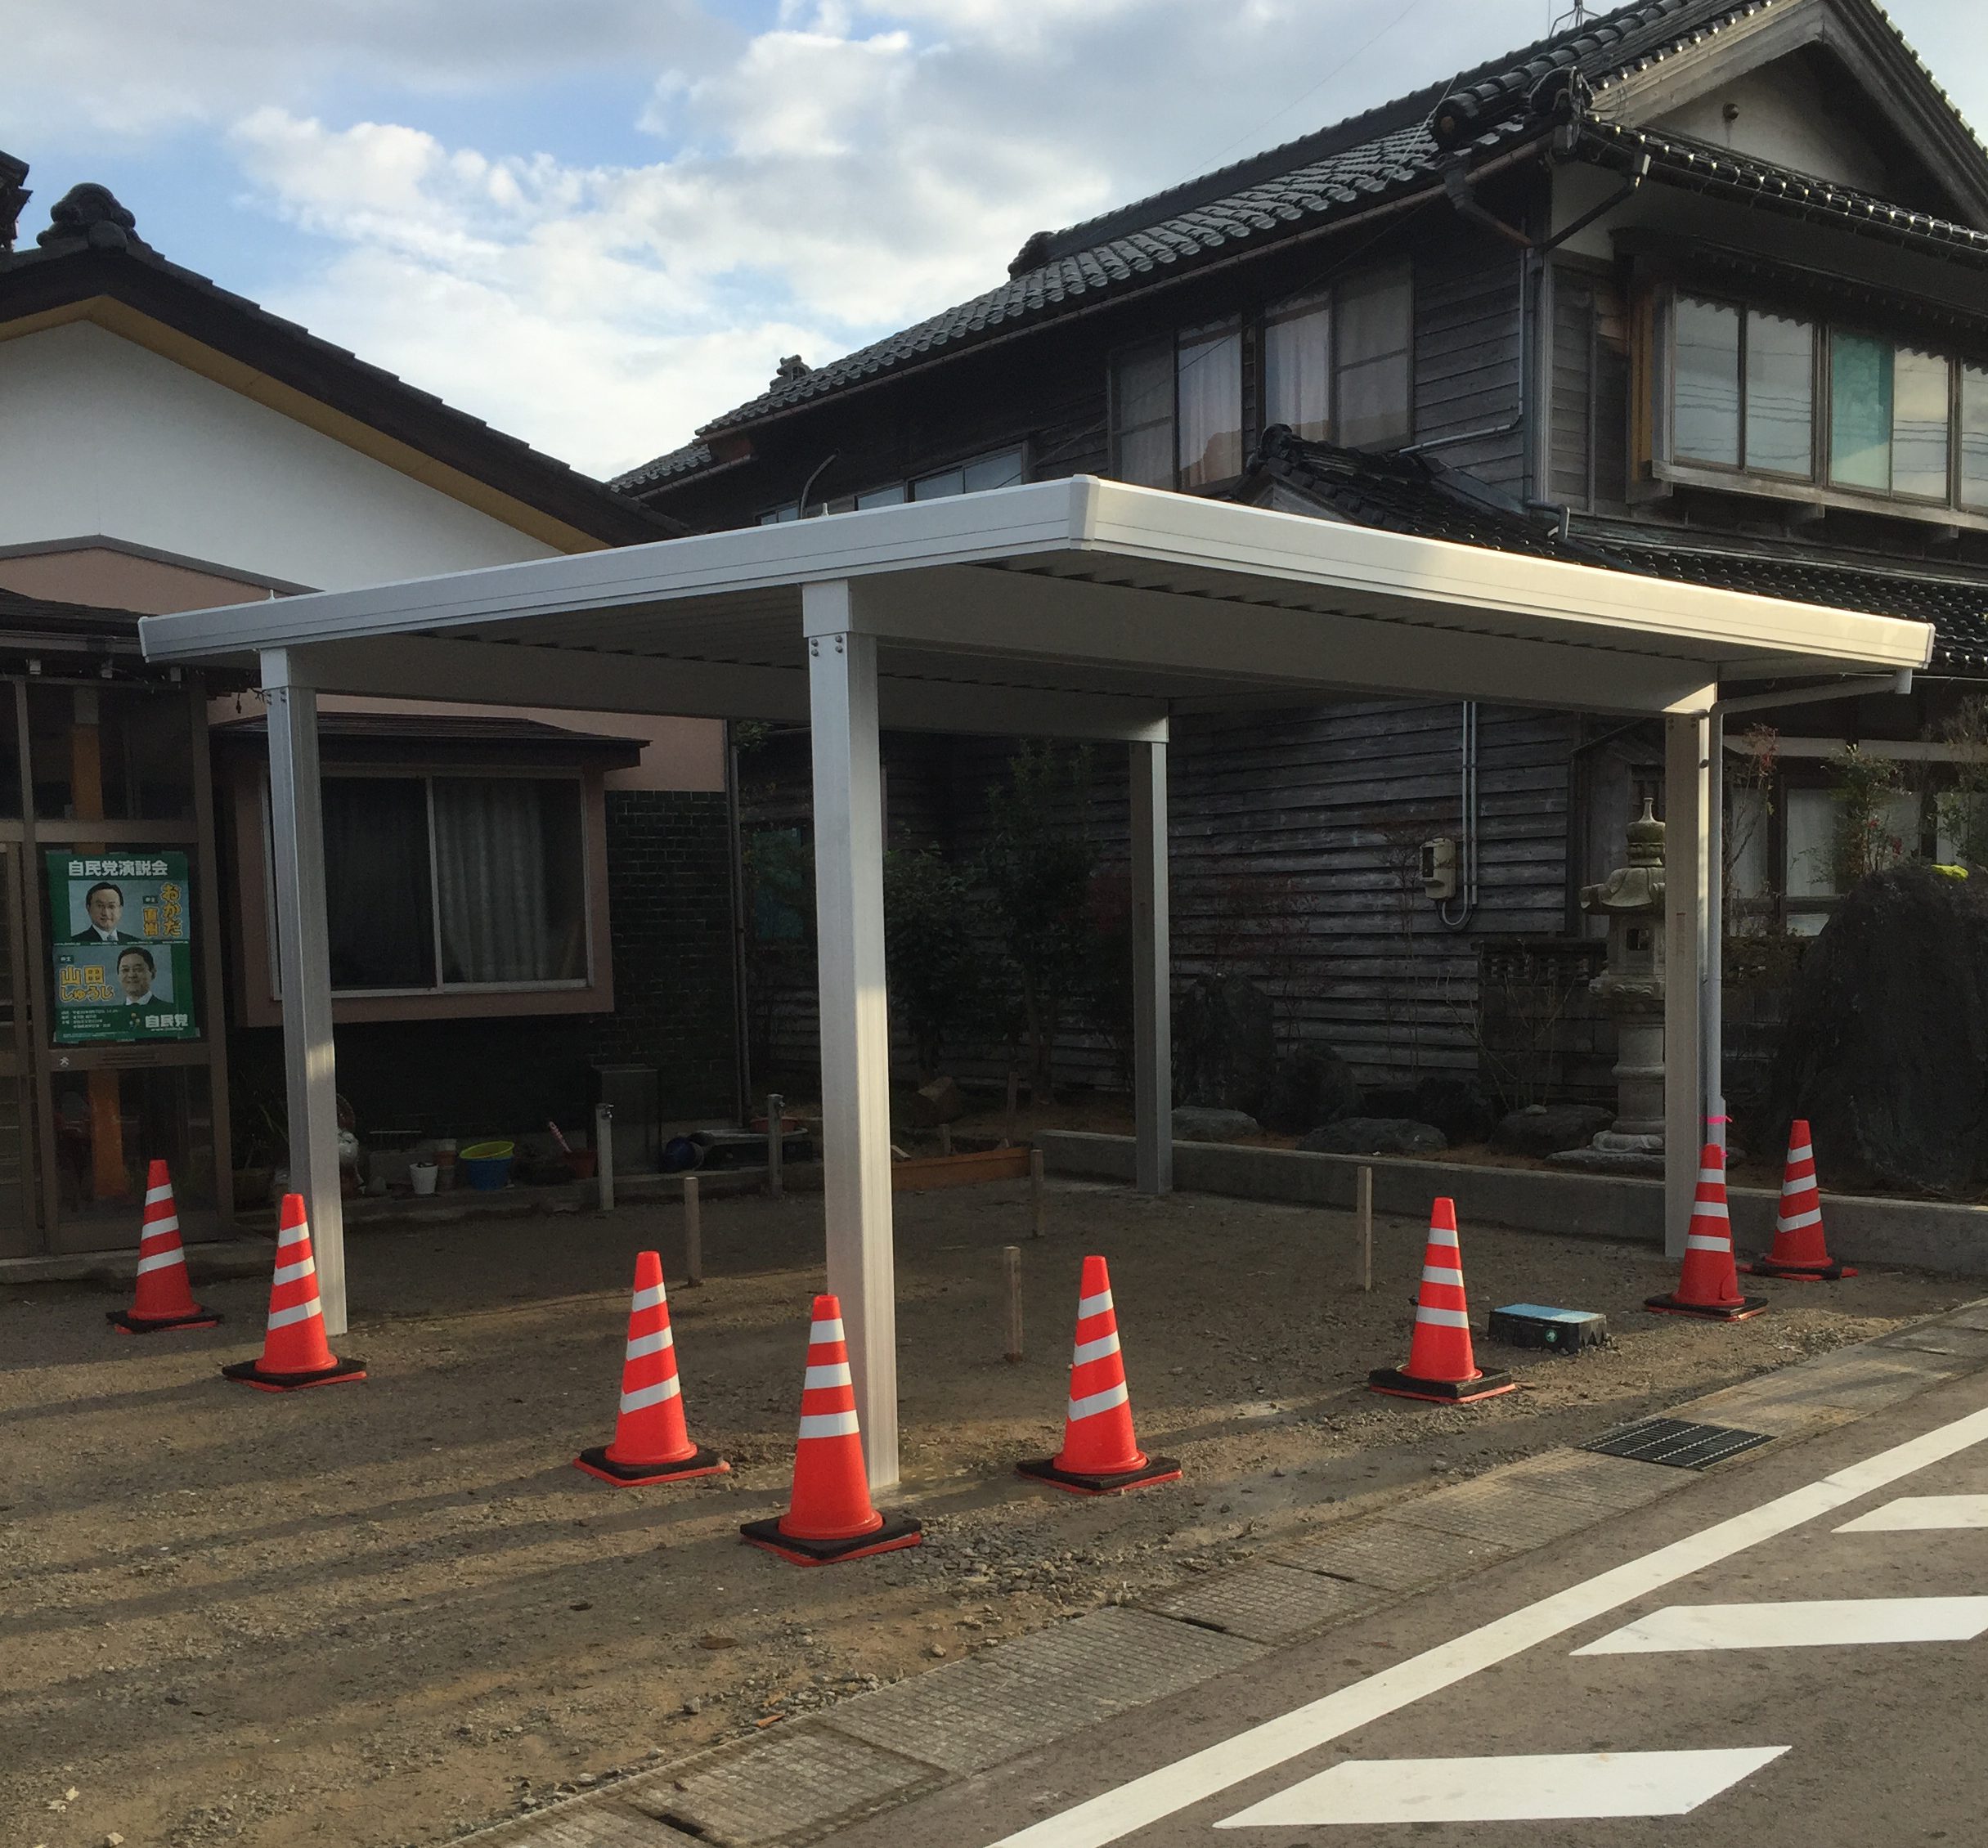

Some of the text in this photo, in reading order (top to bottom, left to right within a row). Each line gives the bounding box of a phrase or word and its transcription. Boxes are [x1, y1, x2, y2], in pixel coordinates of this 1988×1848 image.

[69, 860, 168, 877] 自民党演説会
[161, 882, 182, 936] おかだ
[60, 965, 105, 985] 山田
[60, 985, 114, 1002] しゅうじ
[145, 1014, 188, 1029] 自民党
